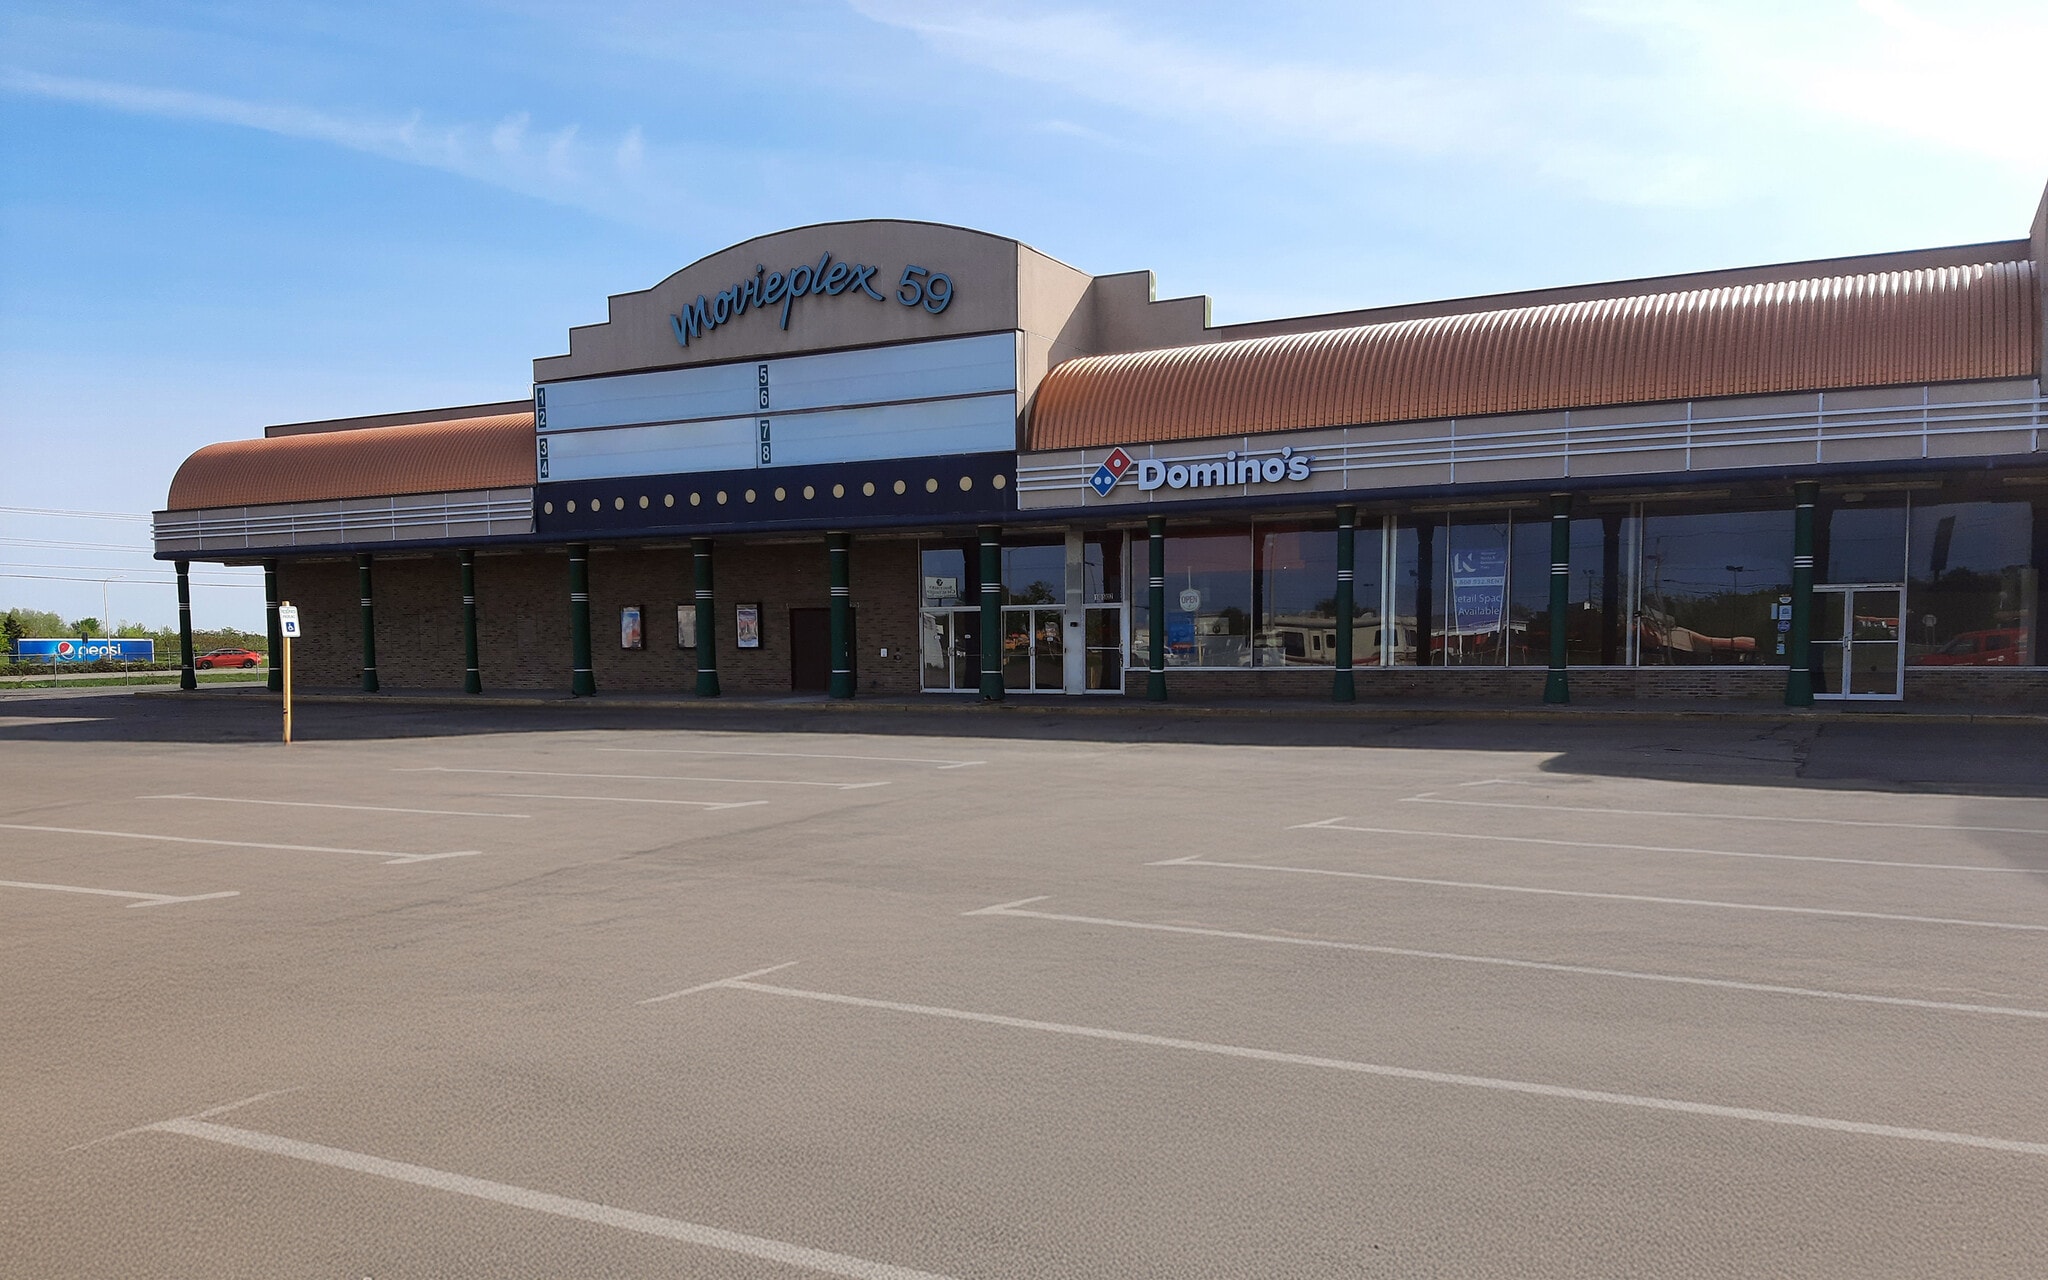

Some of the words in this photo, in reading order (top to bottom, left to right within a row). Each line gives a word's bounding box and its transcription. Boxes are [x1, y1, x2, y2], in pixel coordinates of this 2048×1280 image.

[896, 264, 955, 315] 59
[760, 367, 768, 384] 5
[760, 390, 768, 406] 6
[540, 410, 546, 426] 2
[761, 423, 769, 439] 7
[541, 441, 547, 456] 3
[762, 445, 770, 461] 8
[541, 460, 548, 476] 4
[1138, 446, 1311, 491] Domino's
[1182, 595, 1198, 604] OPEN
[1454, 594, 1477, 603] etail
[1479, 594, 1501, 604] Spac
[1458, 606, 1500, 616] Available
[78, 643, 122, 659] pepsi
